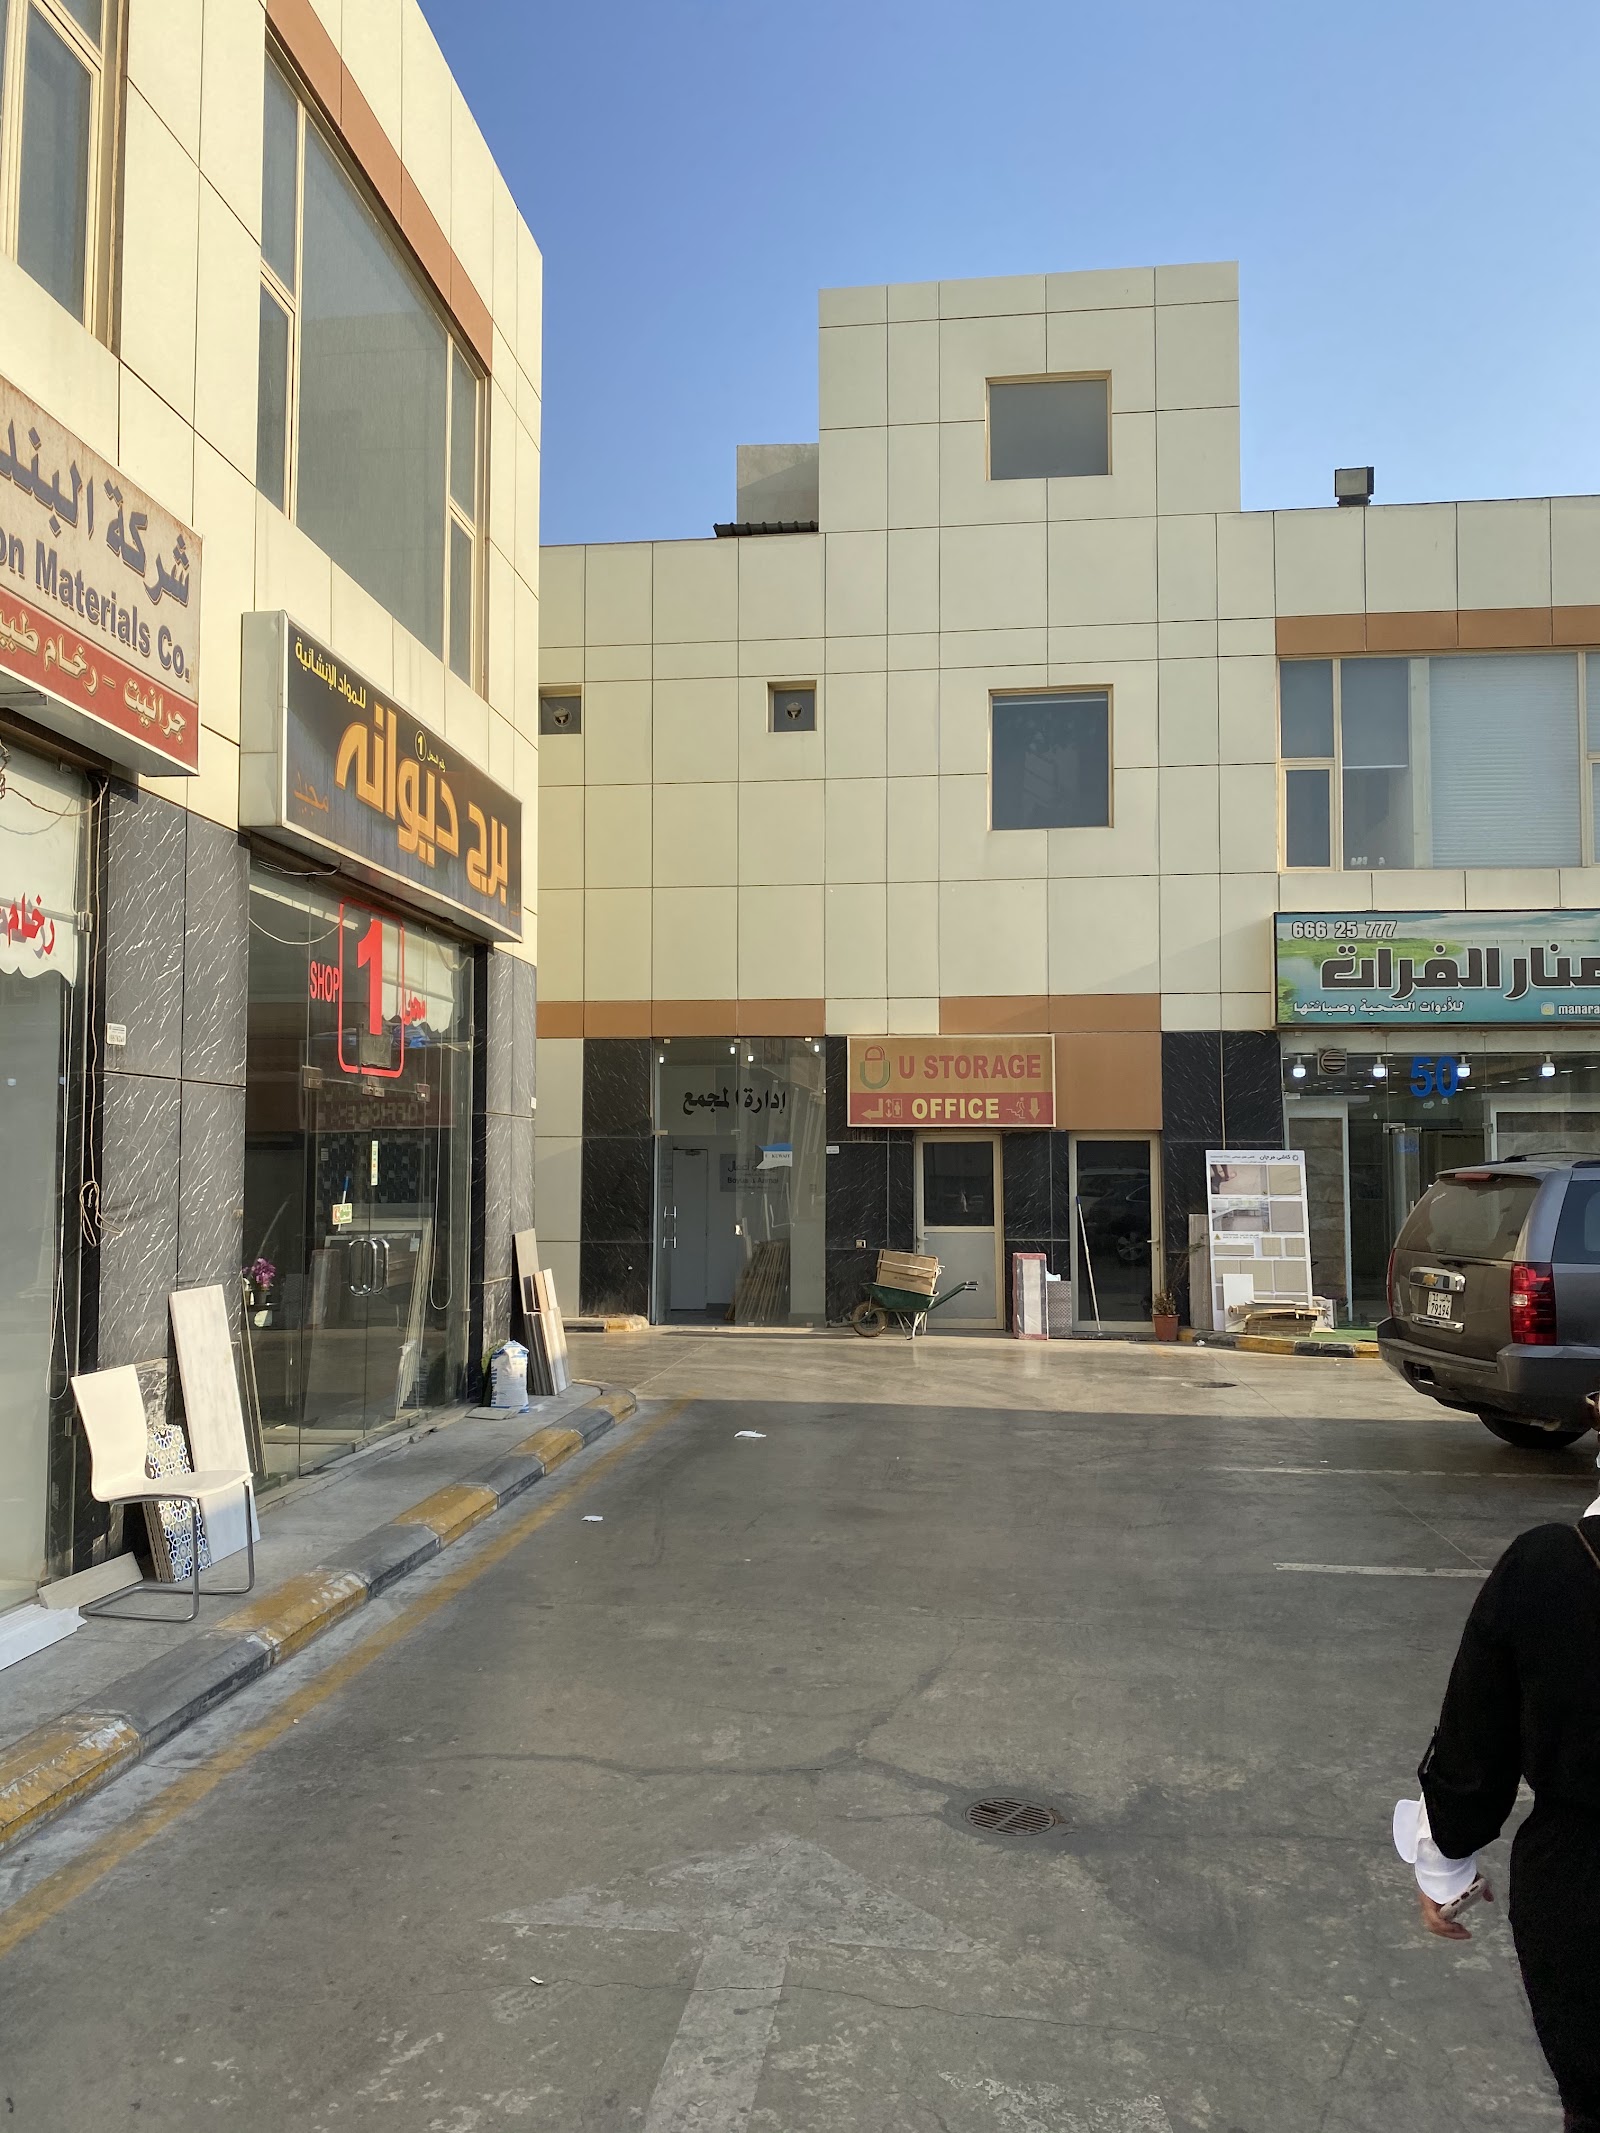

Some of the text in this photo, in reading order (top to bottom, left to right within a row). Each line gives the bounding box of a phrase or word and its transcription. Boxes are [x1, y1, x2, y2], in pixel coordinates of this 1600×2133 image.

[104, 478, 190, 607] شركة
[35, 538, 151, 658] Materials
[157, 624, 190, 682] Co.
[43, 633, 99, 697] رخام
[295, 637, 366, 709] للمواد الإنشائية
[123, 677, 187, 744] جرانيت
[417, 735, 423, 755] 1
[334, 701, 508, 907] برج ديوانه
[8, 892, 55, 955] رخام
[1292, 919, 1398, 939] 666 25 777
[309, 918, 383, 1036] SHOP 1
[1320, 942, 1600, 1000] منار الفرات
[1293, 996, 1465, 1016] للأدوات الصحية وصيانتها
[899, 1054, 1042, 1080] U STORAGE
[1410, 1055, 1458, 1098] 50
[682, 1086, 786, 1116] إدارة المجمع
[911, 1098, 1000, 1120] OFFICE
